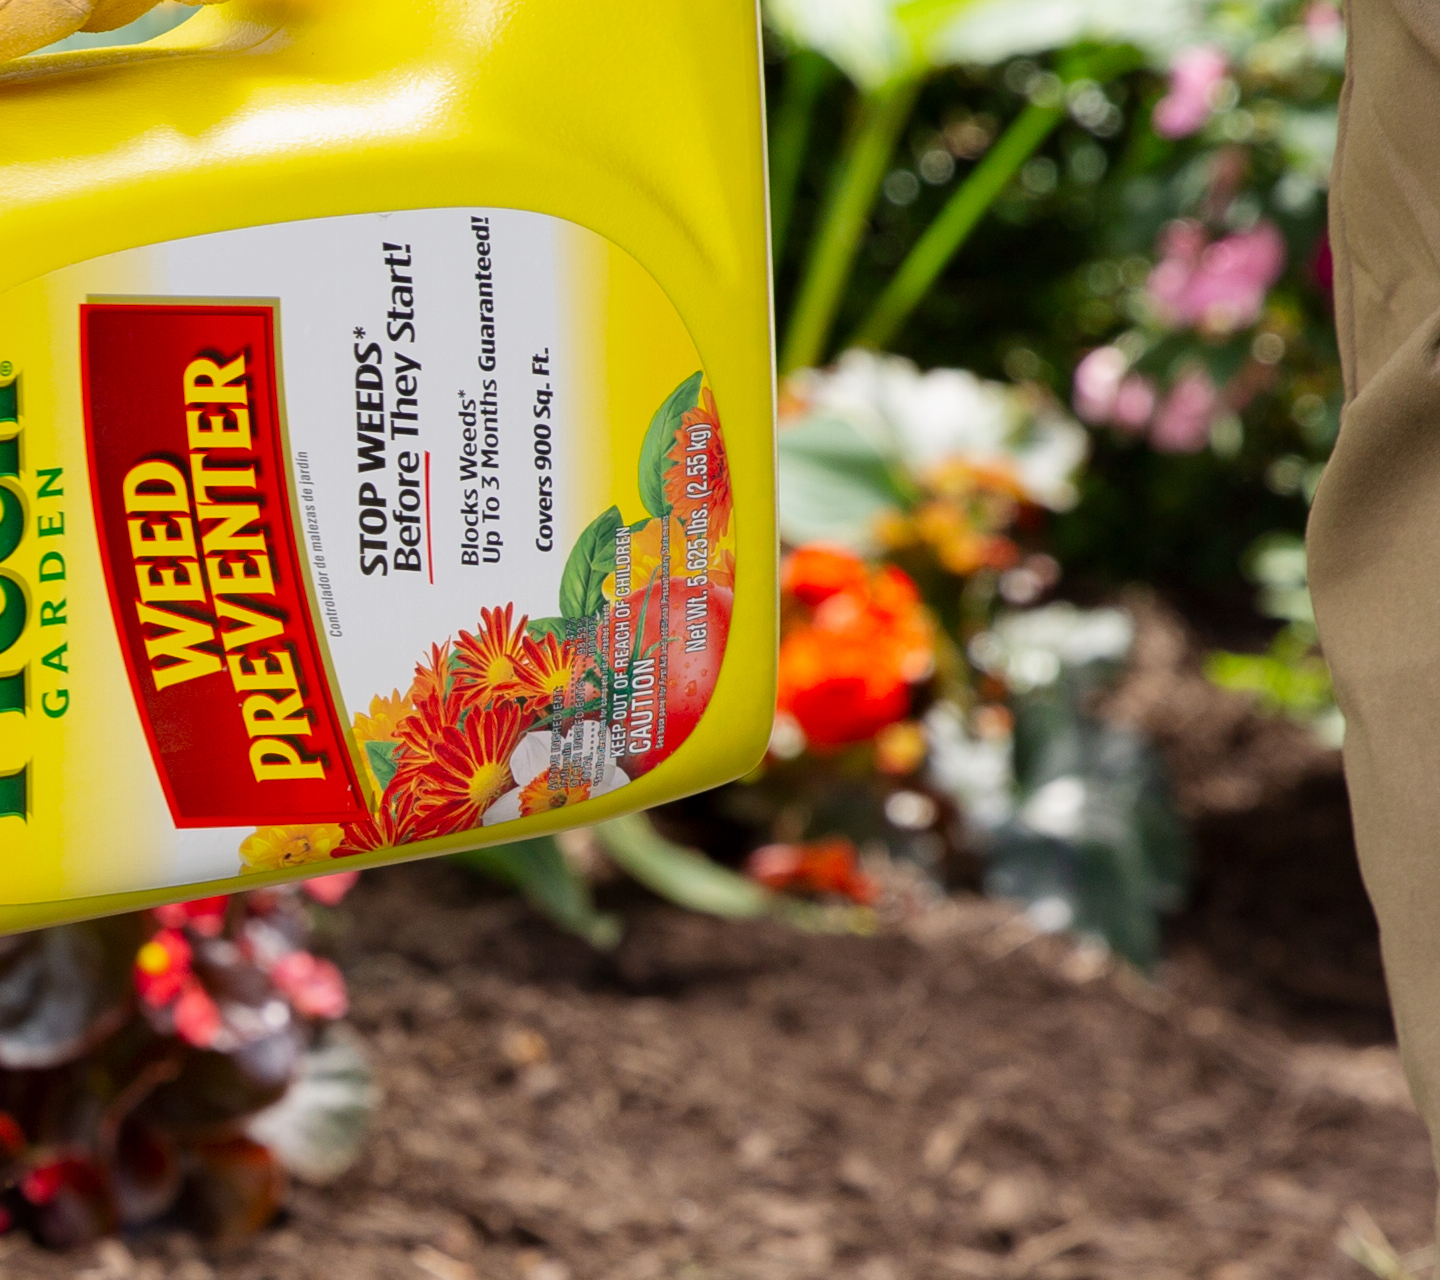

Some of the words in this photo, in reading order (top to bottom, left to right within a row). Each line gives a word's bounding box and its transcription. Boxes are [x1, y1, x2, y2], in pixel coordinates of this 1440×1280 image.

[382, 242, 415, 343] Start!
[471, 216, 496, 372] Guaranteed!
[531, 347, 550, 376] Ft.
[391, 352, 421, 440] They
[533, 383, 553, 419] Sq.
[480, 379, 499, 469] Months
[533, 424, 552, 470] 900
[685, 424, 711, 450] kg)
[295, 451, 315, 485] jardín
[482, 476, 499, 489] 3
[685, 454, 712, 499] (2.55
[301, 488, 314, 502] de
[393, 451, 422, 572] Before
[482, 496, 500, 522] To
[535, 476, 553, 552] Covers
[305, 505, 323, 551] malezas
[358, 482, 388, 576] STOP
[460, 489, 479, 566] Blocks
[685, 503, 708, 534] lbs.
[183, 350, 326, 783] PREVENTER
[314, 556, 326, 568] de
[483, 531, 503, 564] Up
[615, 526, 630, 596] CHILDREN
[685, 538, 708, 586] 5.625
[36, 466, 70, 719] GARDEN
[123, 459, 223, 692] WEED
[317, 571, 343, 637] Controlador
[615, 600, 630, 618] OF
[685, 590, 708, 621] Wt.
[615, 622, 630, 668] REACH
[685, 622, 707, 652] Net
[614, 671, 629, 688] OF
[613, 693, 628, 720] OUT
[629, 658, 655, 754] CAUTION
[610, 724, 627, 757] KEEP
